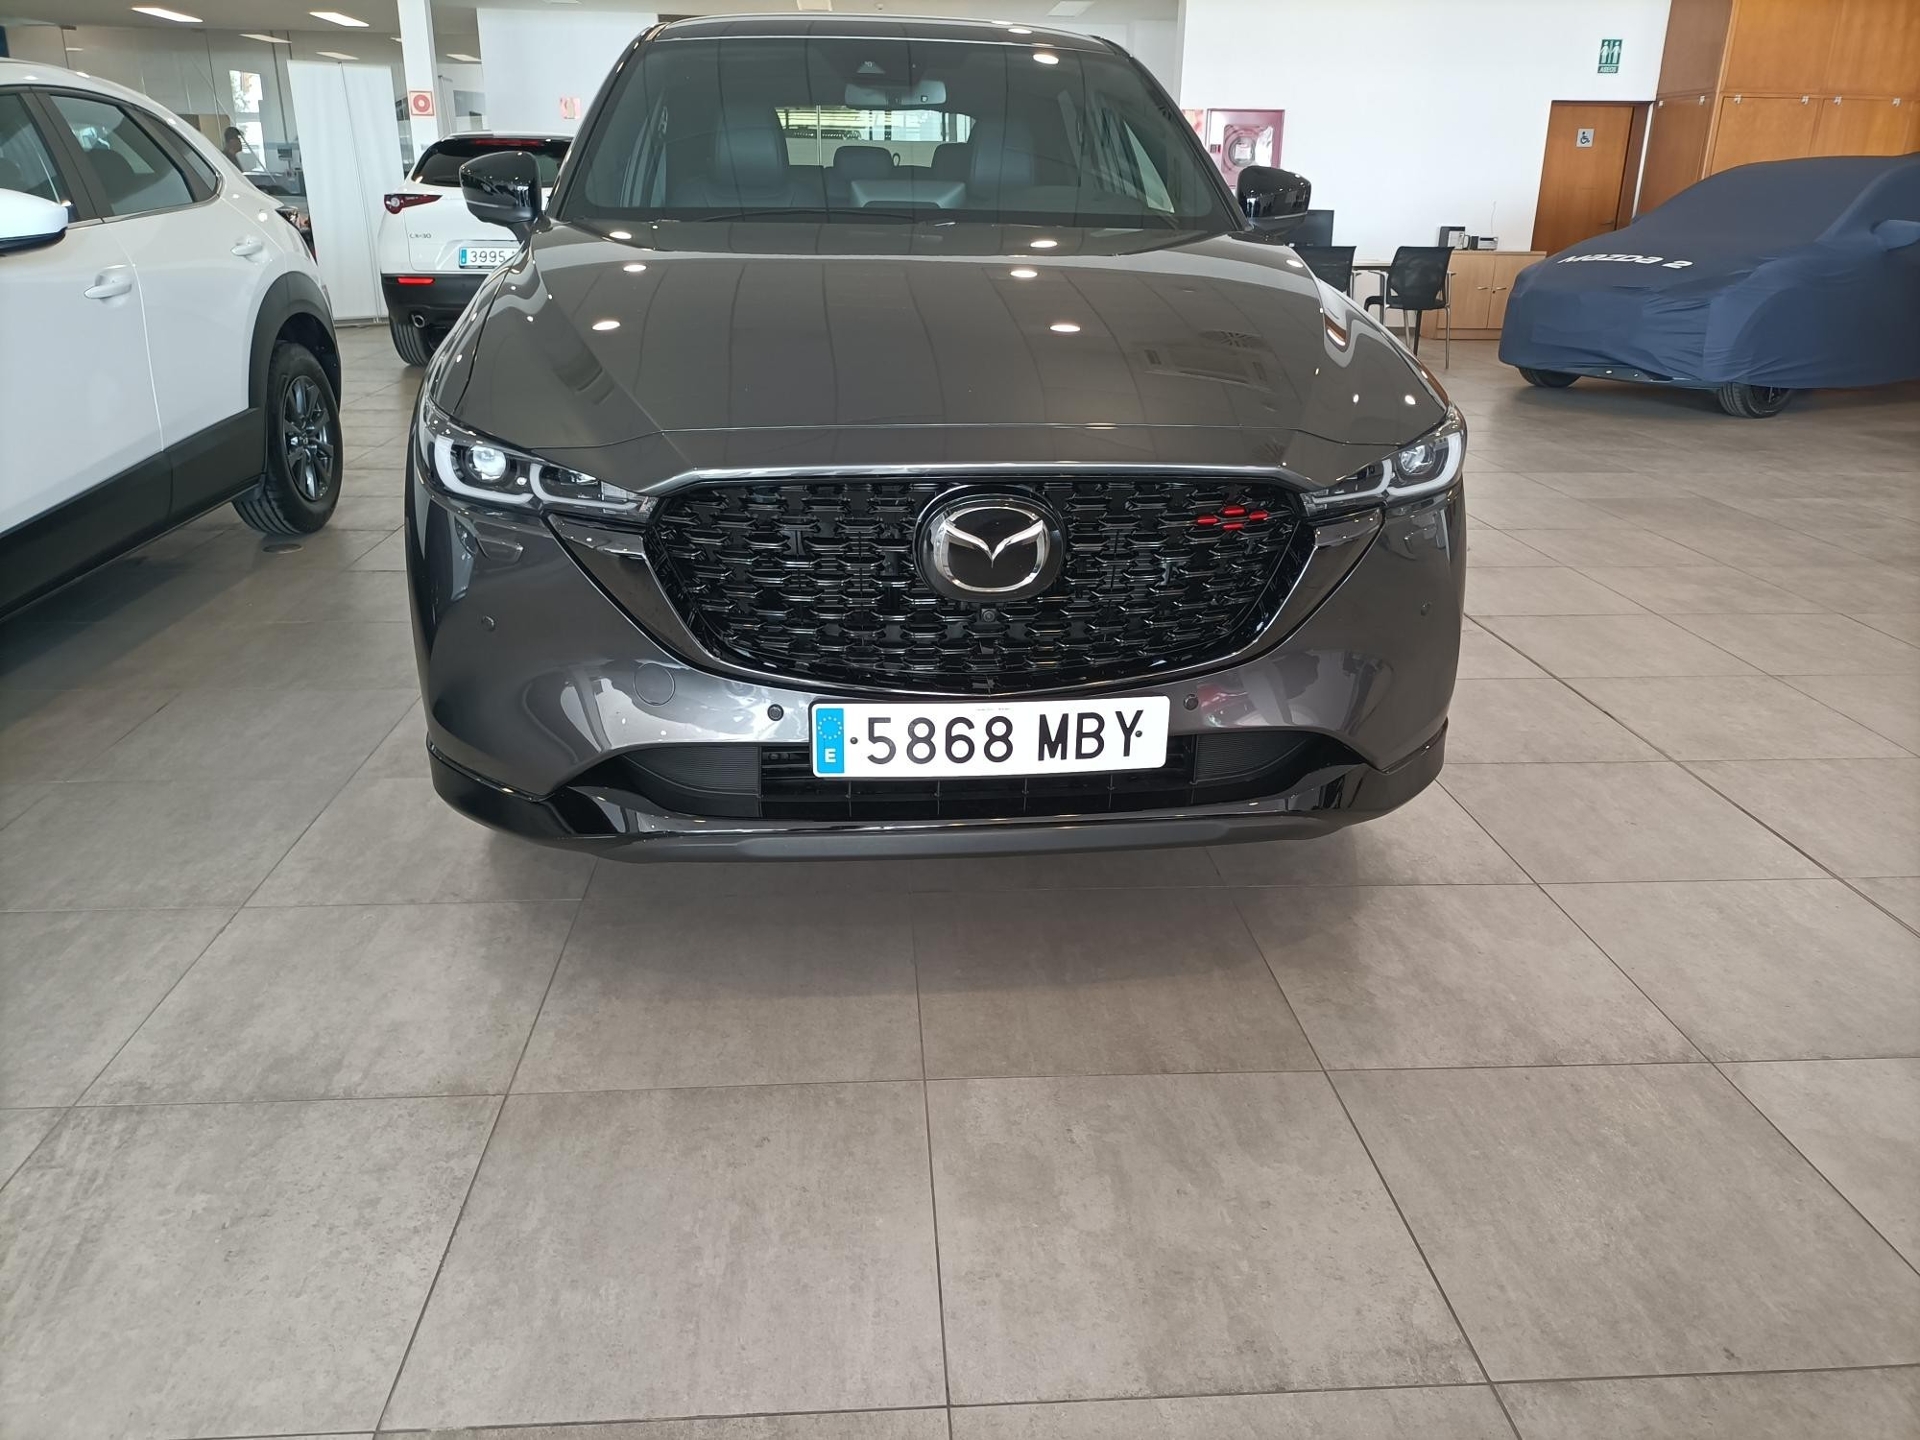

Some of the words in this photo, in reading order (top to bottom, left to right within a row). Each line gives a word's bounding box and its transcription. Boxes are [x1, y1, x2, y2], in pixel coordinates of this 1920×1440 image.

[470, 250, 506, 263] 3995
[1661, 260, 1693, 269] 2
[867, 715, 1014, 765] 5868
[1038, 709, 1144, 762] MBY
[824, 748, 837, 763] E
